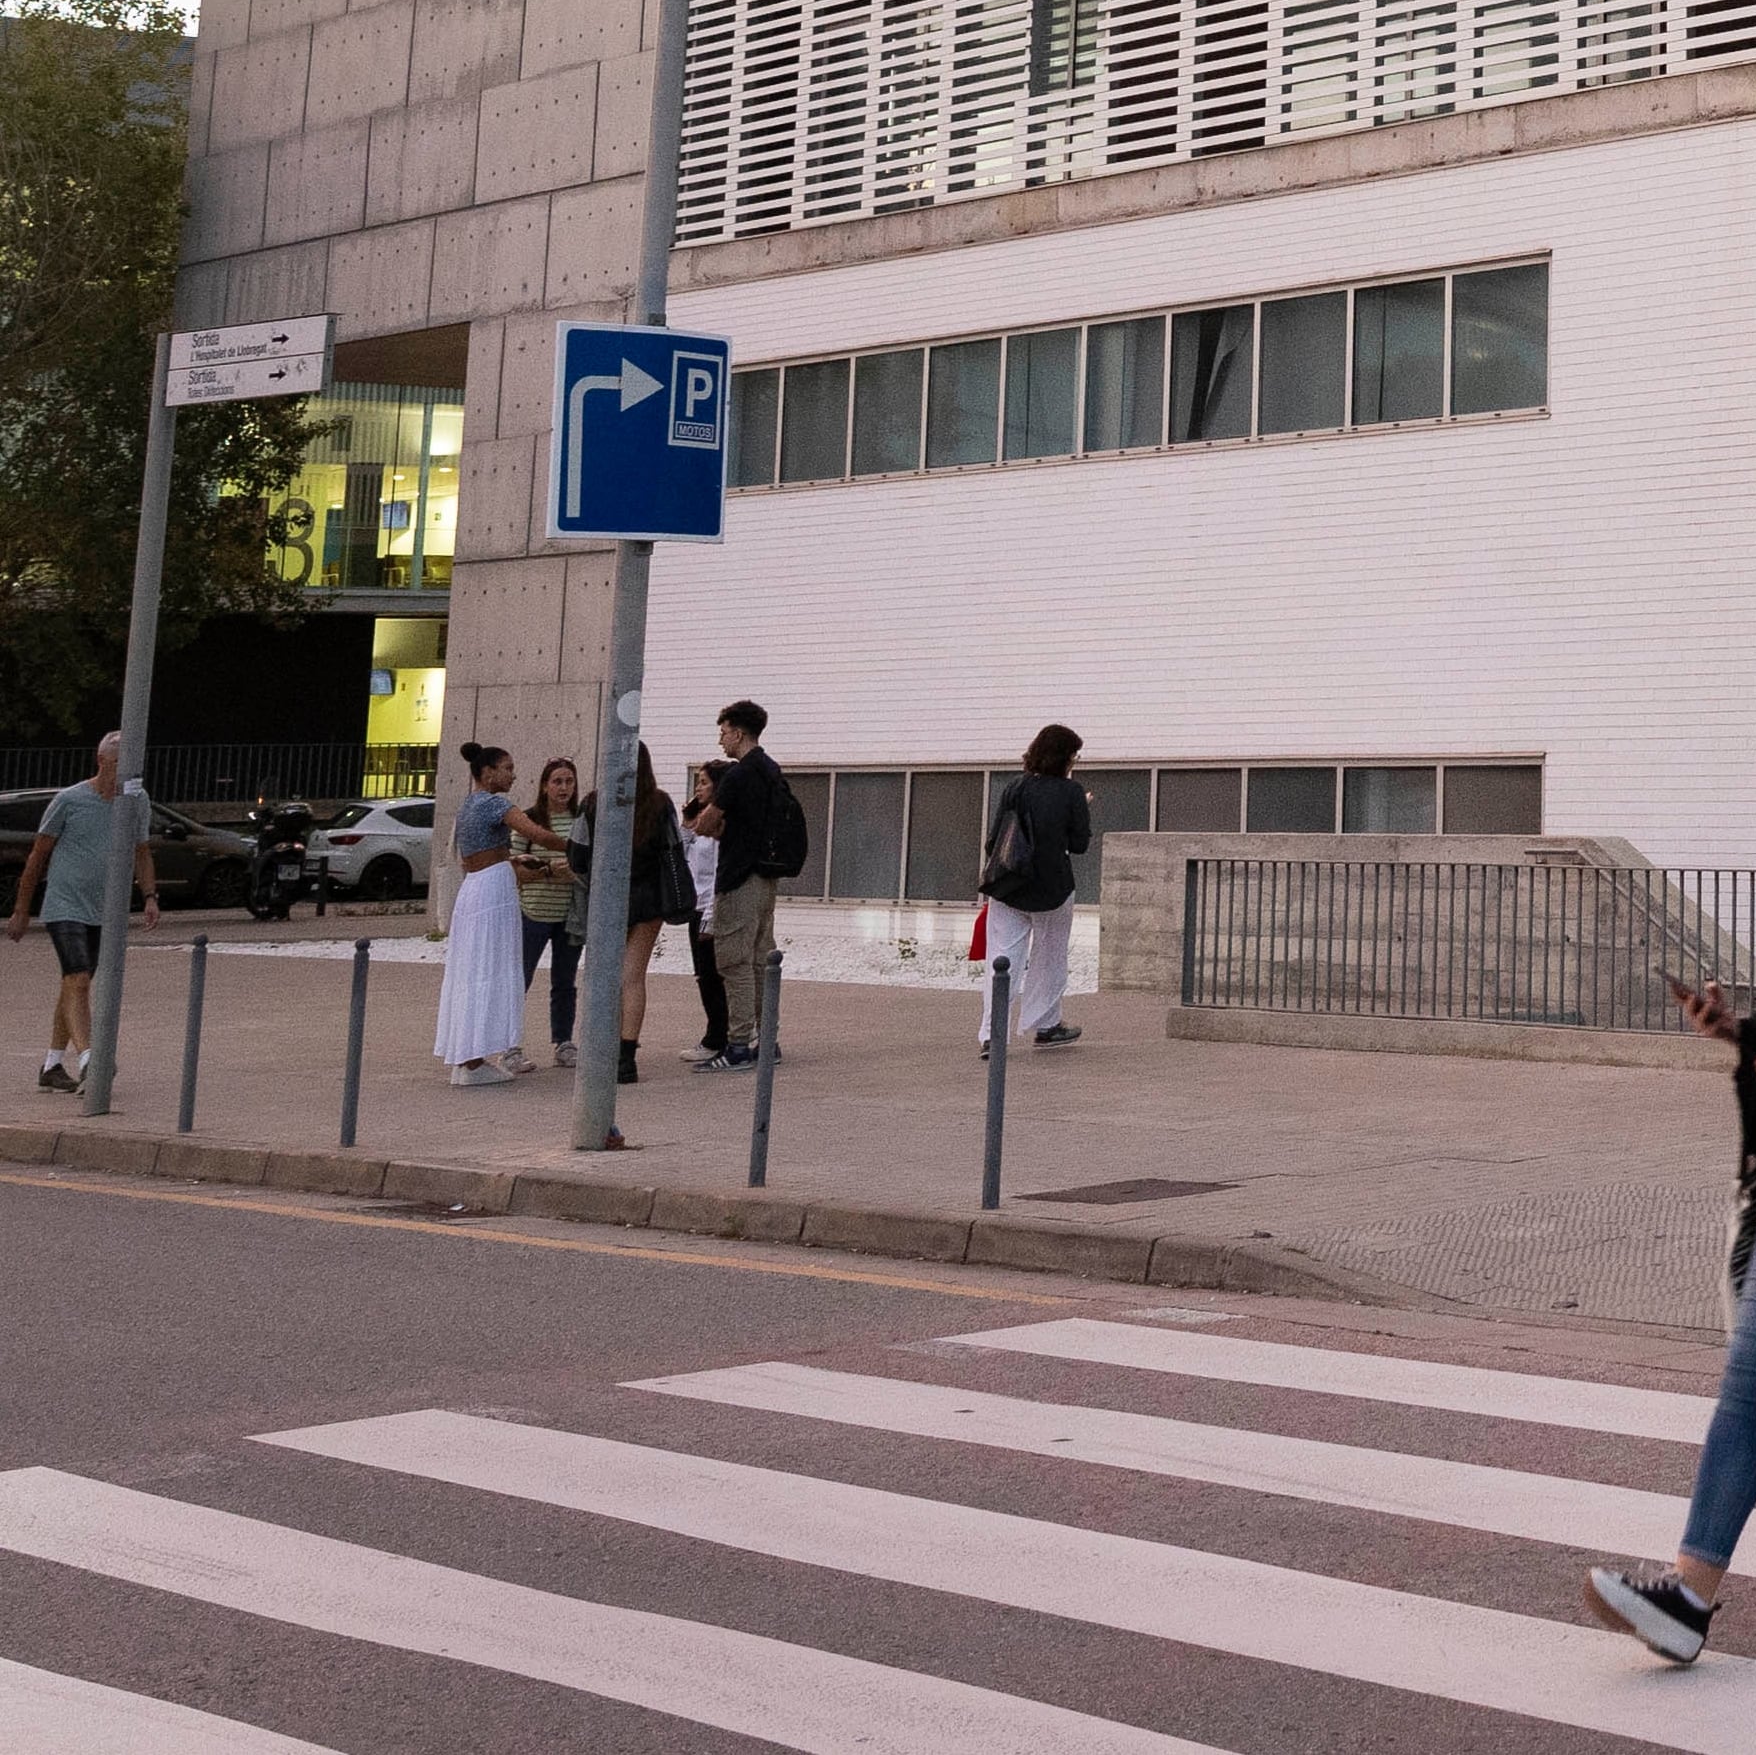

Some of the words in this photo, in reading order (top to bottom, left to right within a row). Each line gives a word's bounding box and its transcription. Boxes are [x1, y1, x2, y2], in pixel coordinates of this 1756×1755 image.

[191, 333, 220, 349] Sortida
[228, 346, 235, 357] de
[237, 343, 267, 357] Llobregat
[188, 370, 217, 386] Sortida
[685, 368, 713, 417] P
[679, 425, 711, 438] MOTOS
